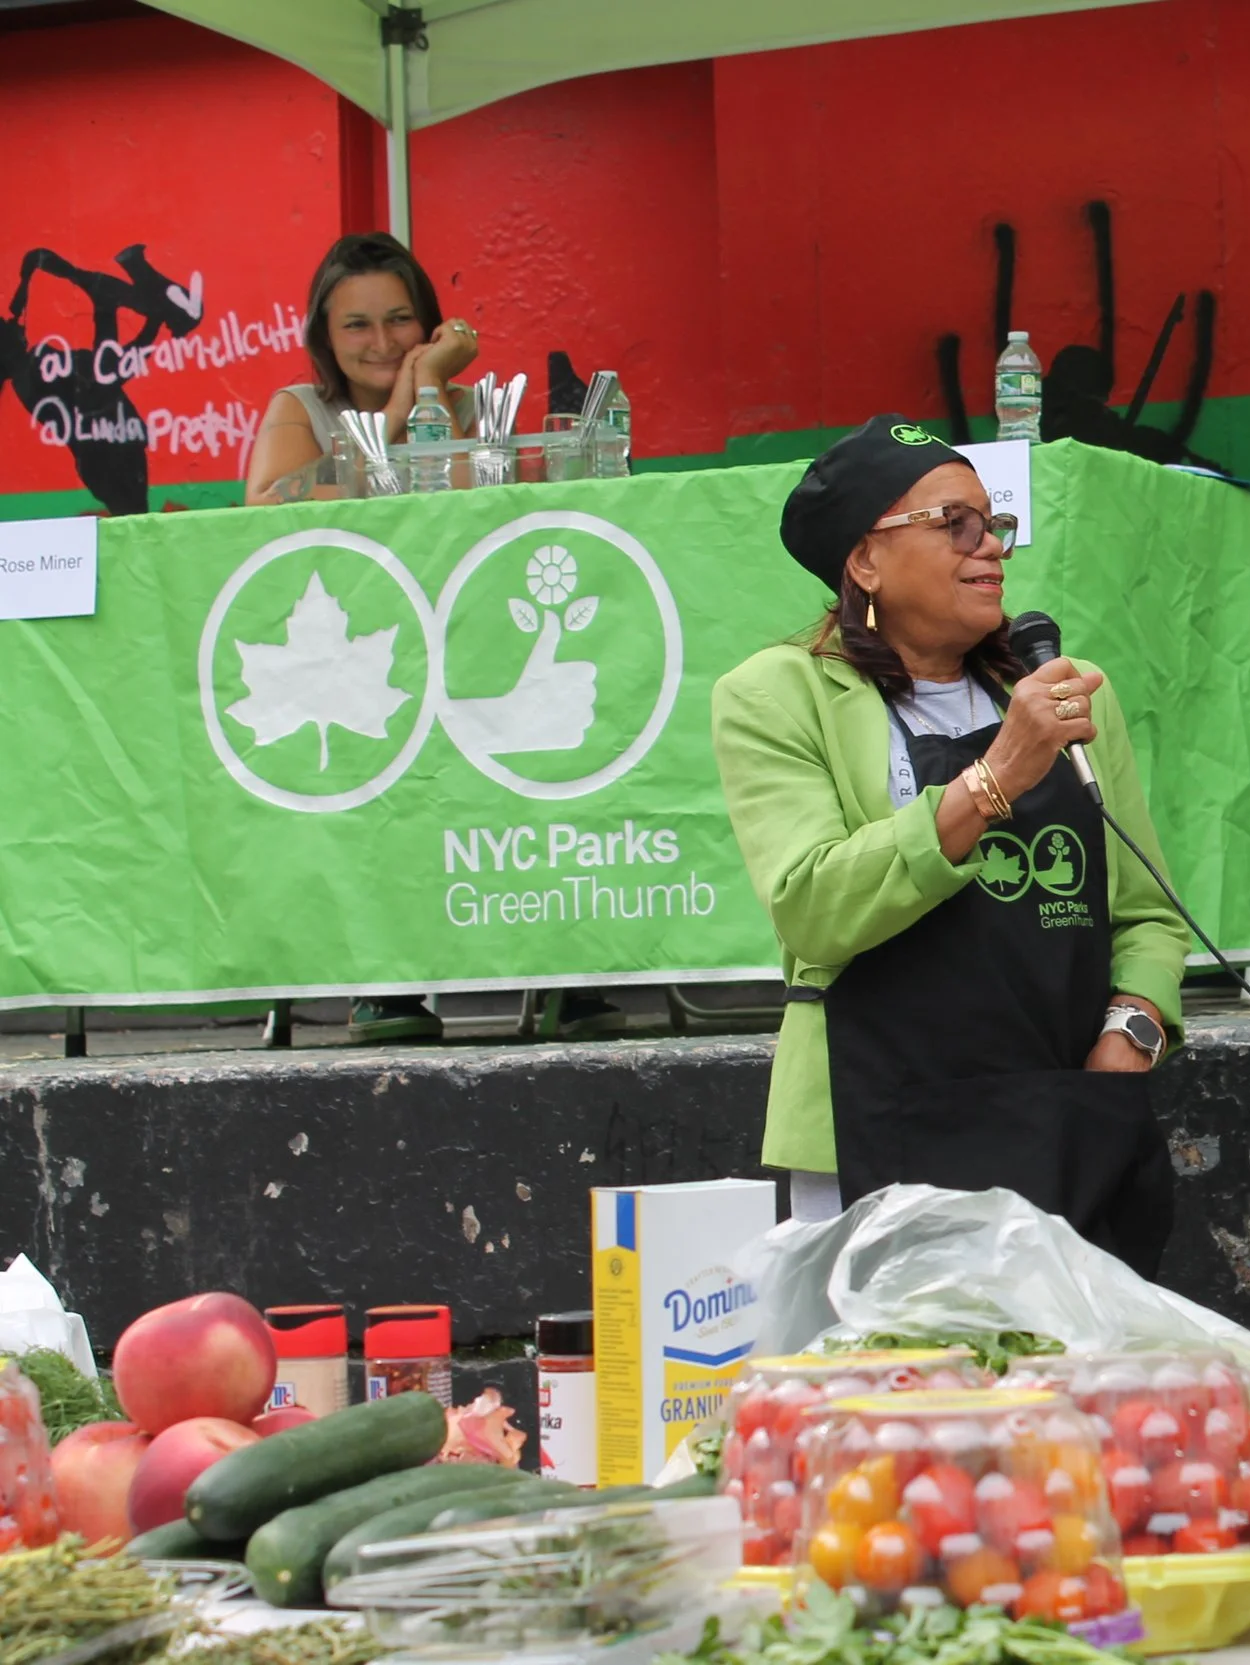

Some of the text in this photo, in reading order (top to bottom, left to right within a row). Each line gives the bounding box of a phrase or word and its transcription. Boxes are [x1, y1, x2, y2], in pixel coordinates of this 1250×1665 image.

[94, 302, 308, 385] Caramellcuti
[989, 487, 1013, 503] ice
[0, 554, 83, 573] Rose Miner
[444, 820, 680, 873] NYC Parks
[445, 871, 716, 927] GreenThumb
[1039, 900, 1089, 915] NYC Parks
[1041, 914, 1094, 929] GreenThumb
